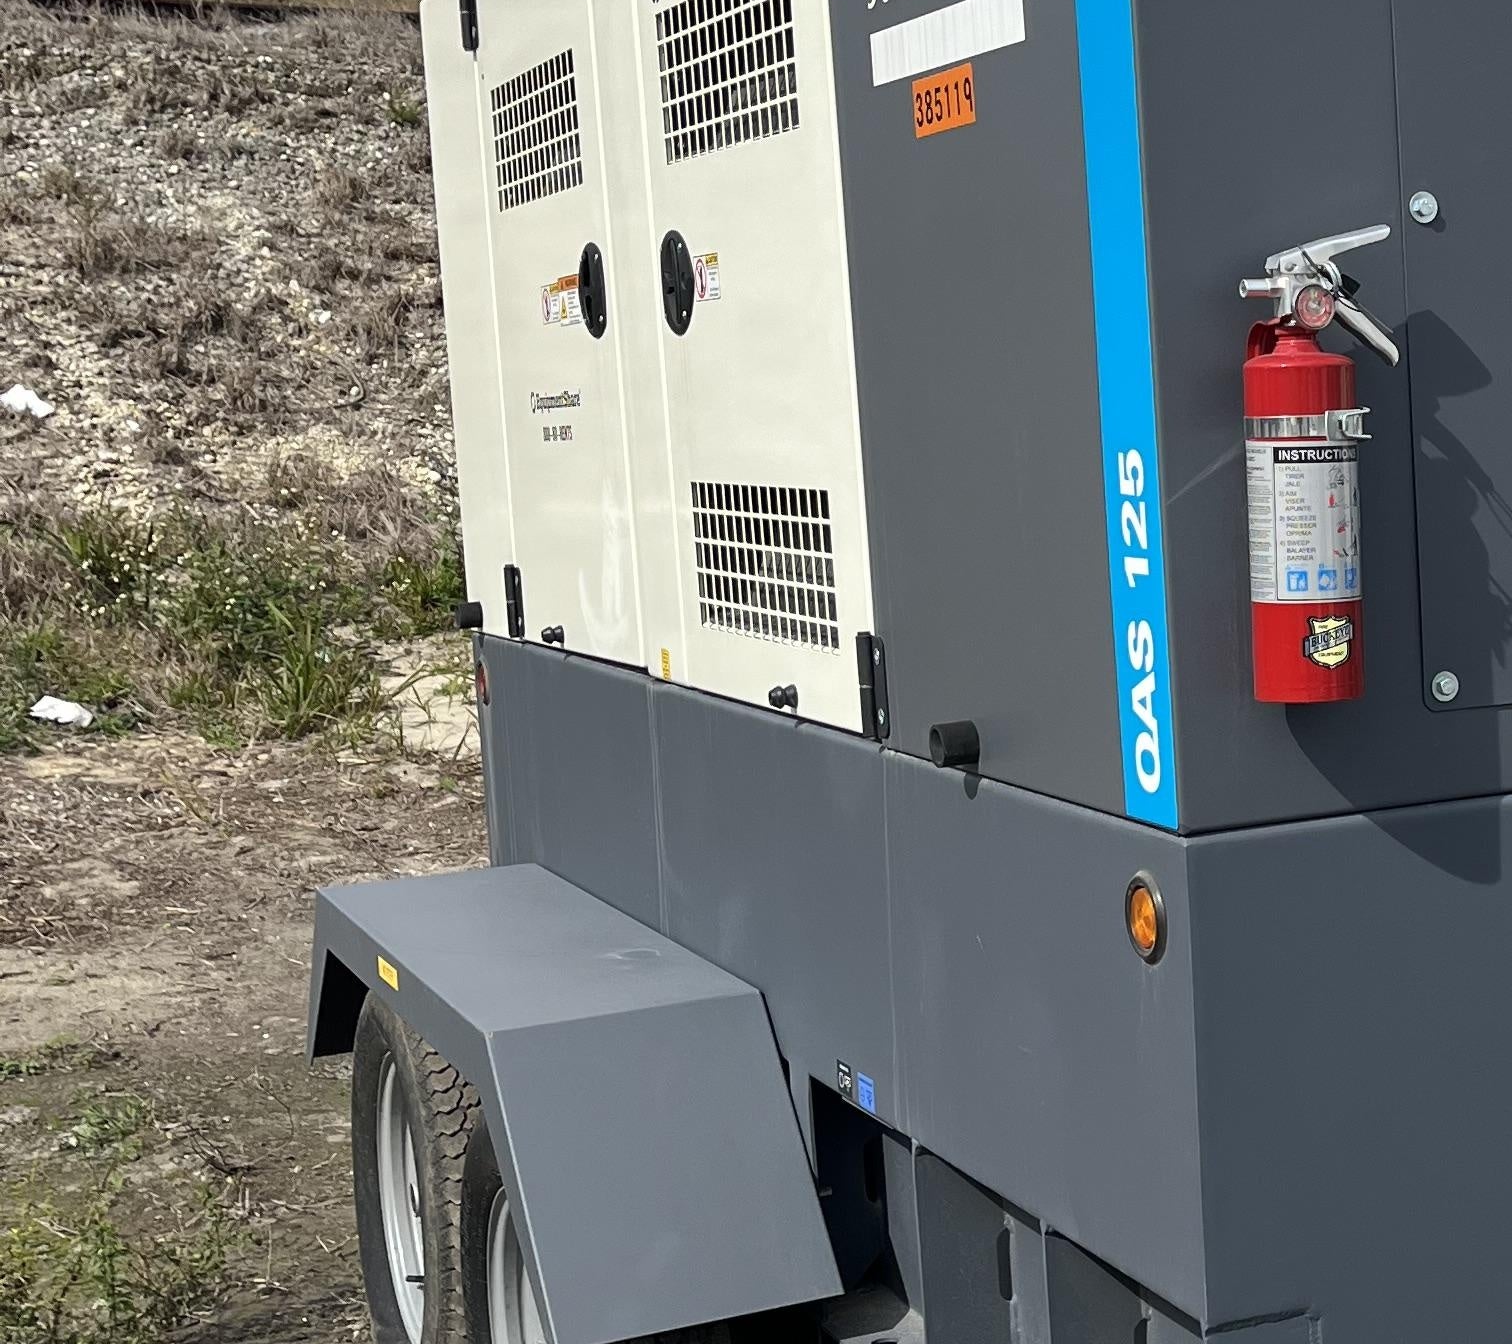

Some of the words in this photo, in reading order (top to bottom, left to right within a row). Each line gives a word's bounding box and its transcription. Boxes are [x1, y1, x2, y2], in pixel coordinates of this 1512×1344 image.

[915, 76, 974, 128] 385119
[1117, 447, 1150, 588] 125
[1311, 625, 1350, 648] BUCKEYE
[1127, 619, 1161, 794] QAS
